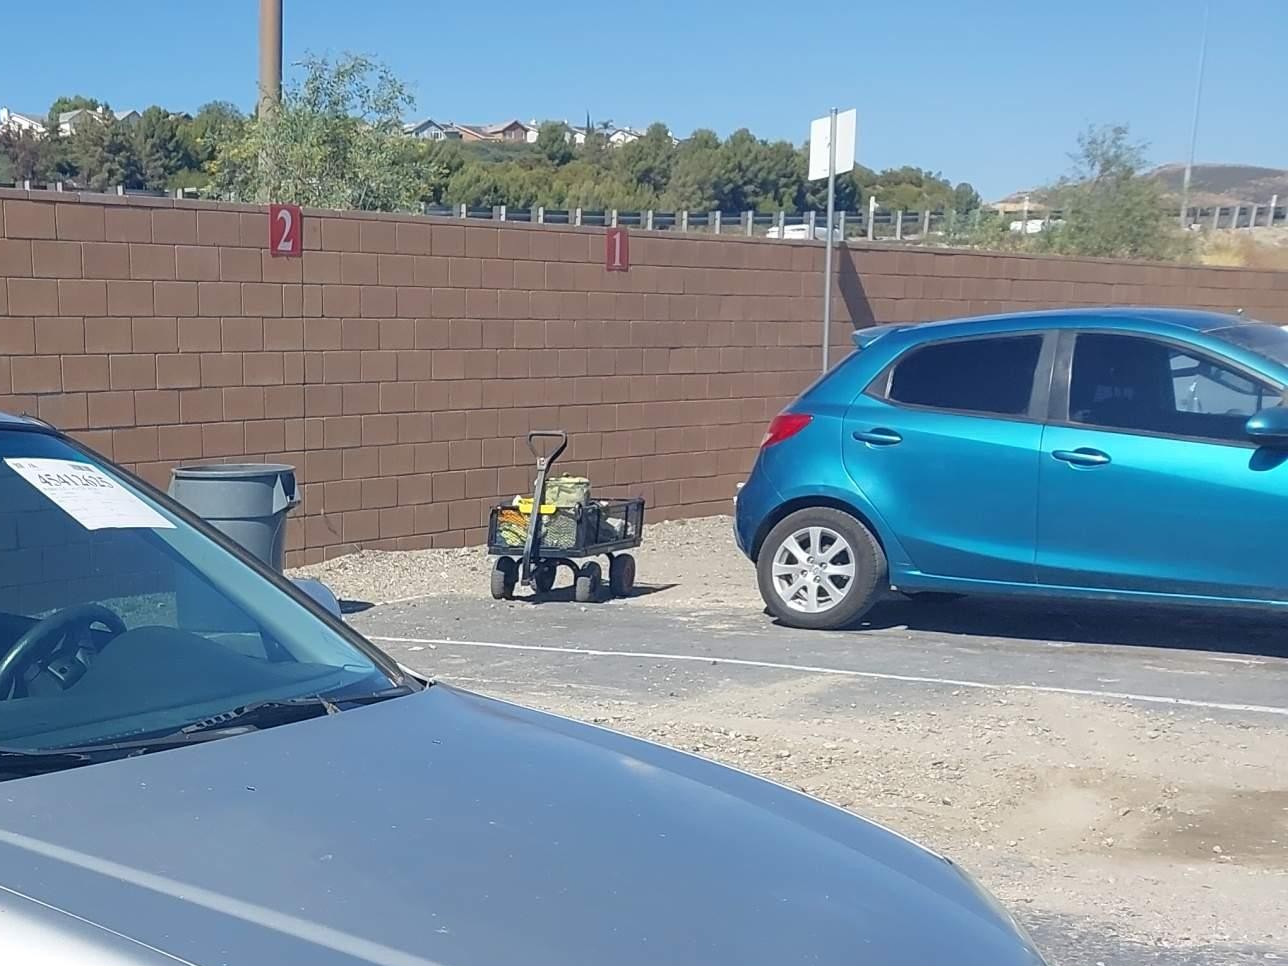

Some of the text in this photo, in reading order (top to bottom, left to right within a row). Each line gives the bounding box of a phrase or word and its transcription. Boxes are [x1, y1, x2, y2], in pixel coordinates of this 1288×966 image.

[276, 208, 293, 251] 2
[612, 231, 622, 266] 1
[38, 473, 114, 489] 45412625
